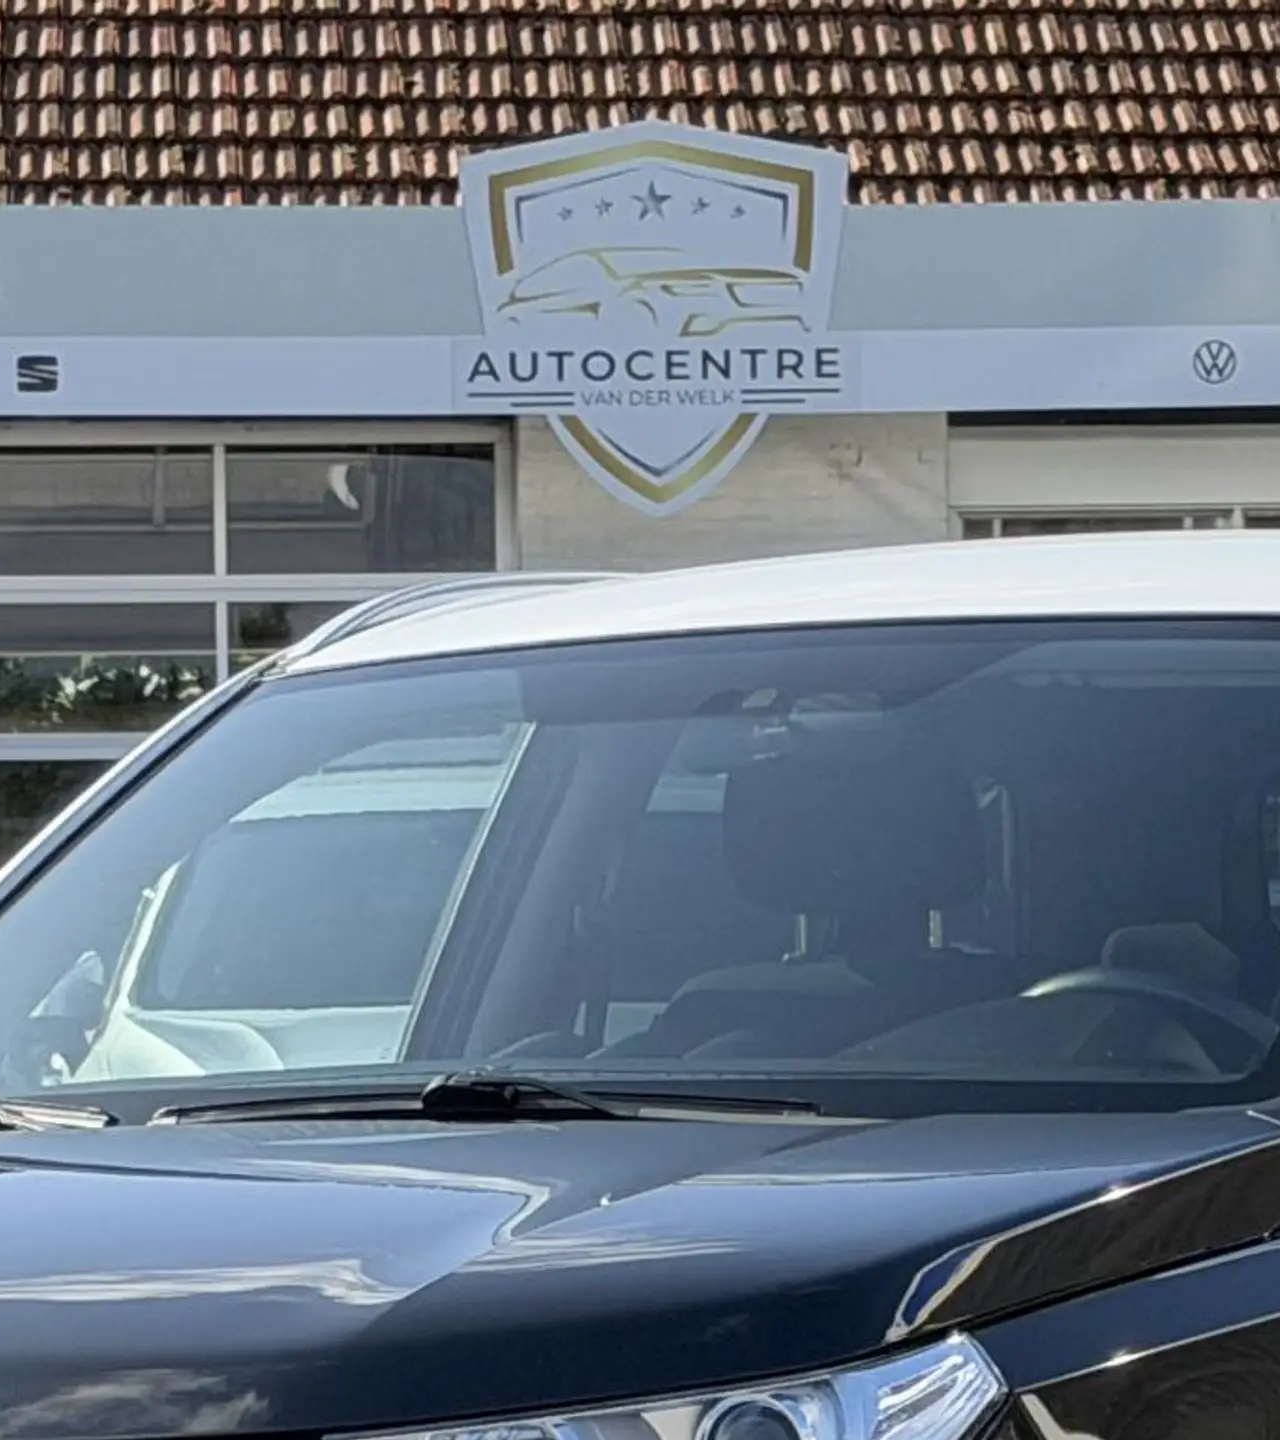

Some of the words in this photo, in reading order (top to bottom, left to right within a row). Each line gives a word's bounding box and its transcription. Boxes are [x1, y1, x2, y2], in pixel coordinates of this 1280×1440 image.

[467, 347, 840, 383] AUTOCENTRE
[580, 390, 623, 406] VAN
[629, 389, 671, 406] DER
[676, 389, 736, 406] WELK
